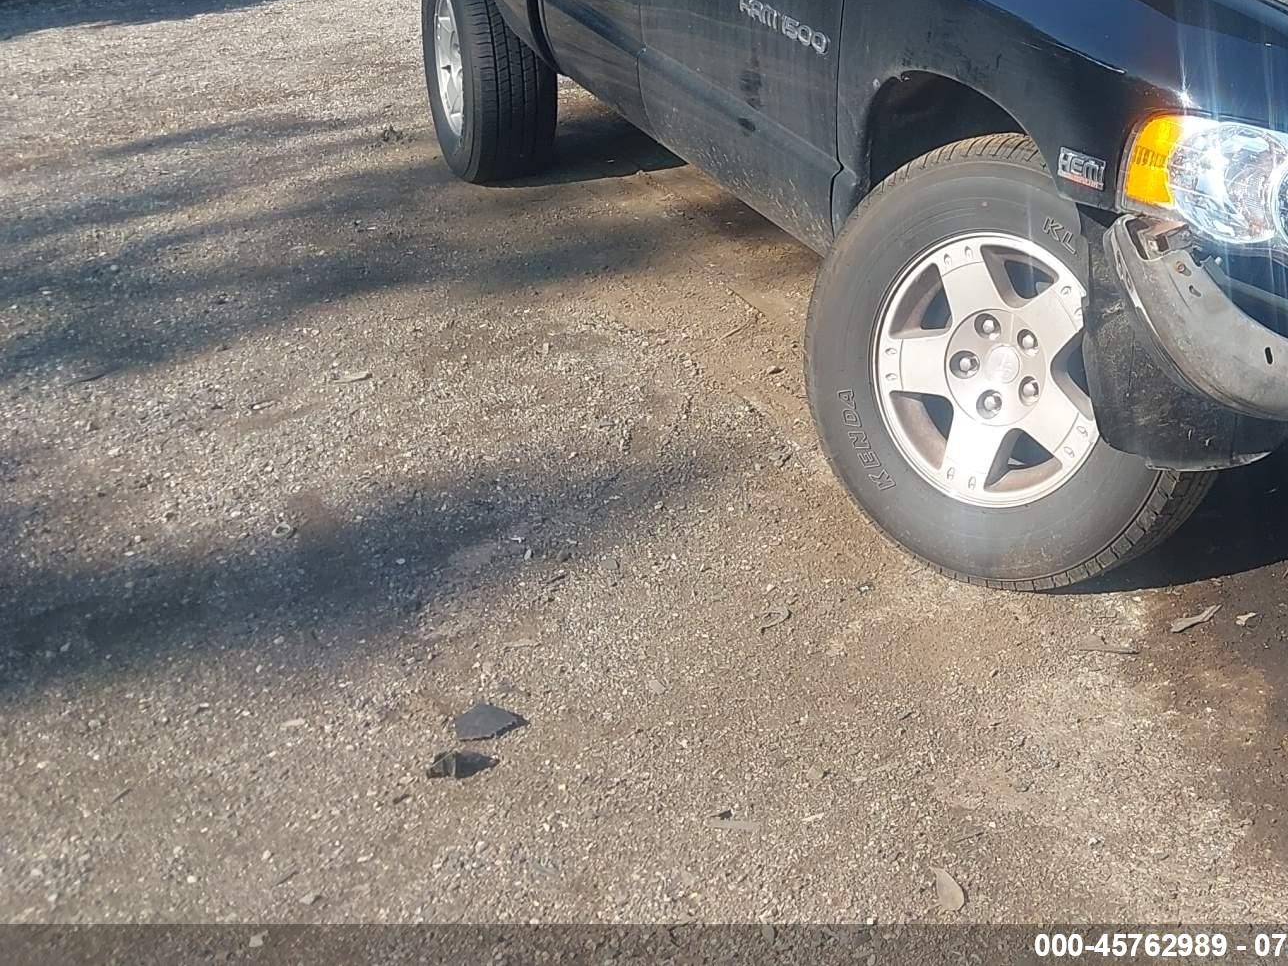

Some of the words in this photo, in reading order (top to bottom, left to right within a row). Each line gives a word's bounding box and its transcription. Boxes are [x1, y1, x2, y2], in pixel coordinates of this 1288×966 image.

[780, 14, 831, 55] 1500
[1043, 217, 1079, 257] KL
[837, 389, 896, 490] KENDA
